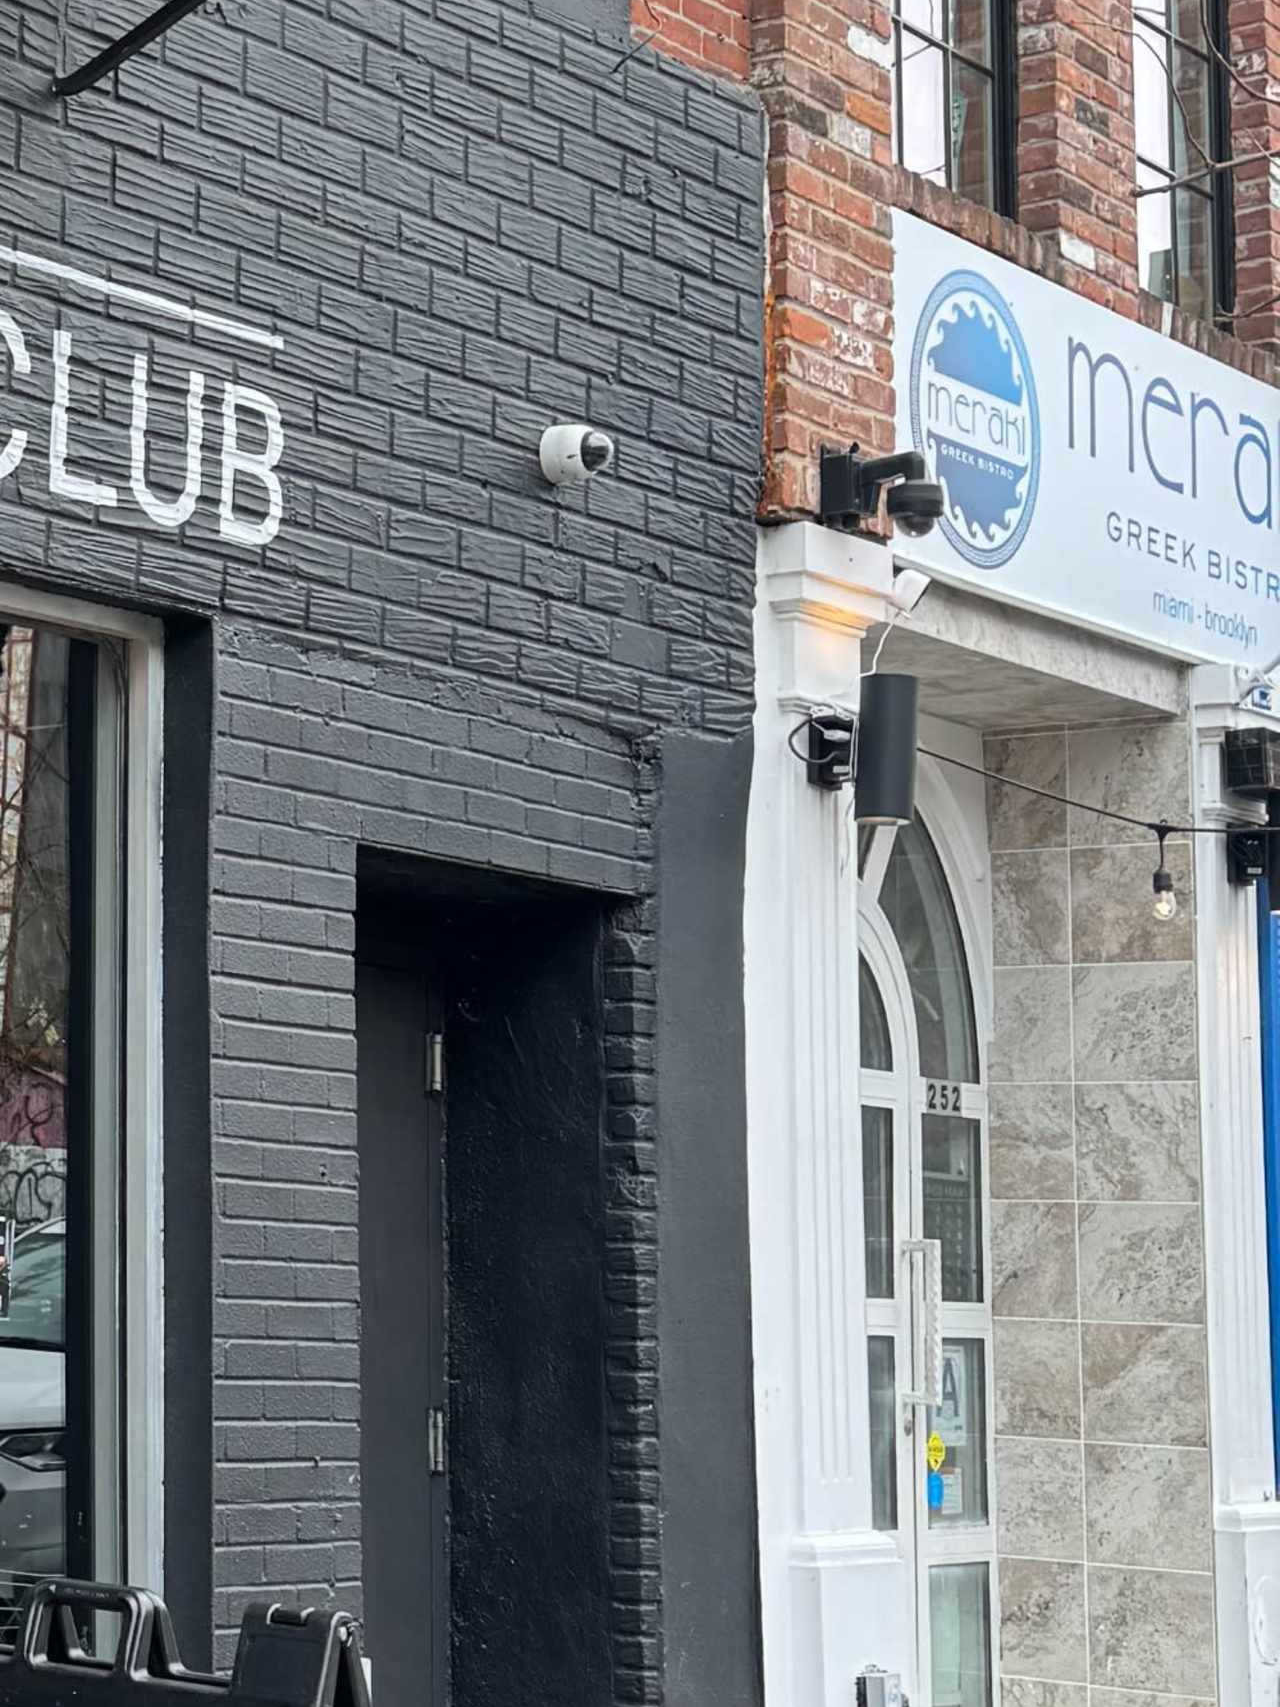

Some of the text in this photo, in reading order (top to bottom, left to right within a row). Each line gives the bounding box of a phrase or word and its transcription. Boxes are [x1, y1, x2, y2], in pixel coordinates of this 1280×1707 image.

[928, 380, 1025, 456] meraki
[1067, 335, 1280, 533] mera
[941, 443, 1014, 481] GREEK BISTRO
[1106, 511, 1197, 572] GREEK
[1152, 590, 1194, 624] miami
[1205, 603, 1258, 651] brooklyn
[928, 1083, 960, 1111] 252
